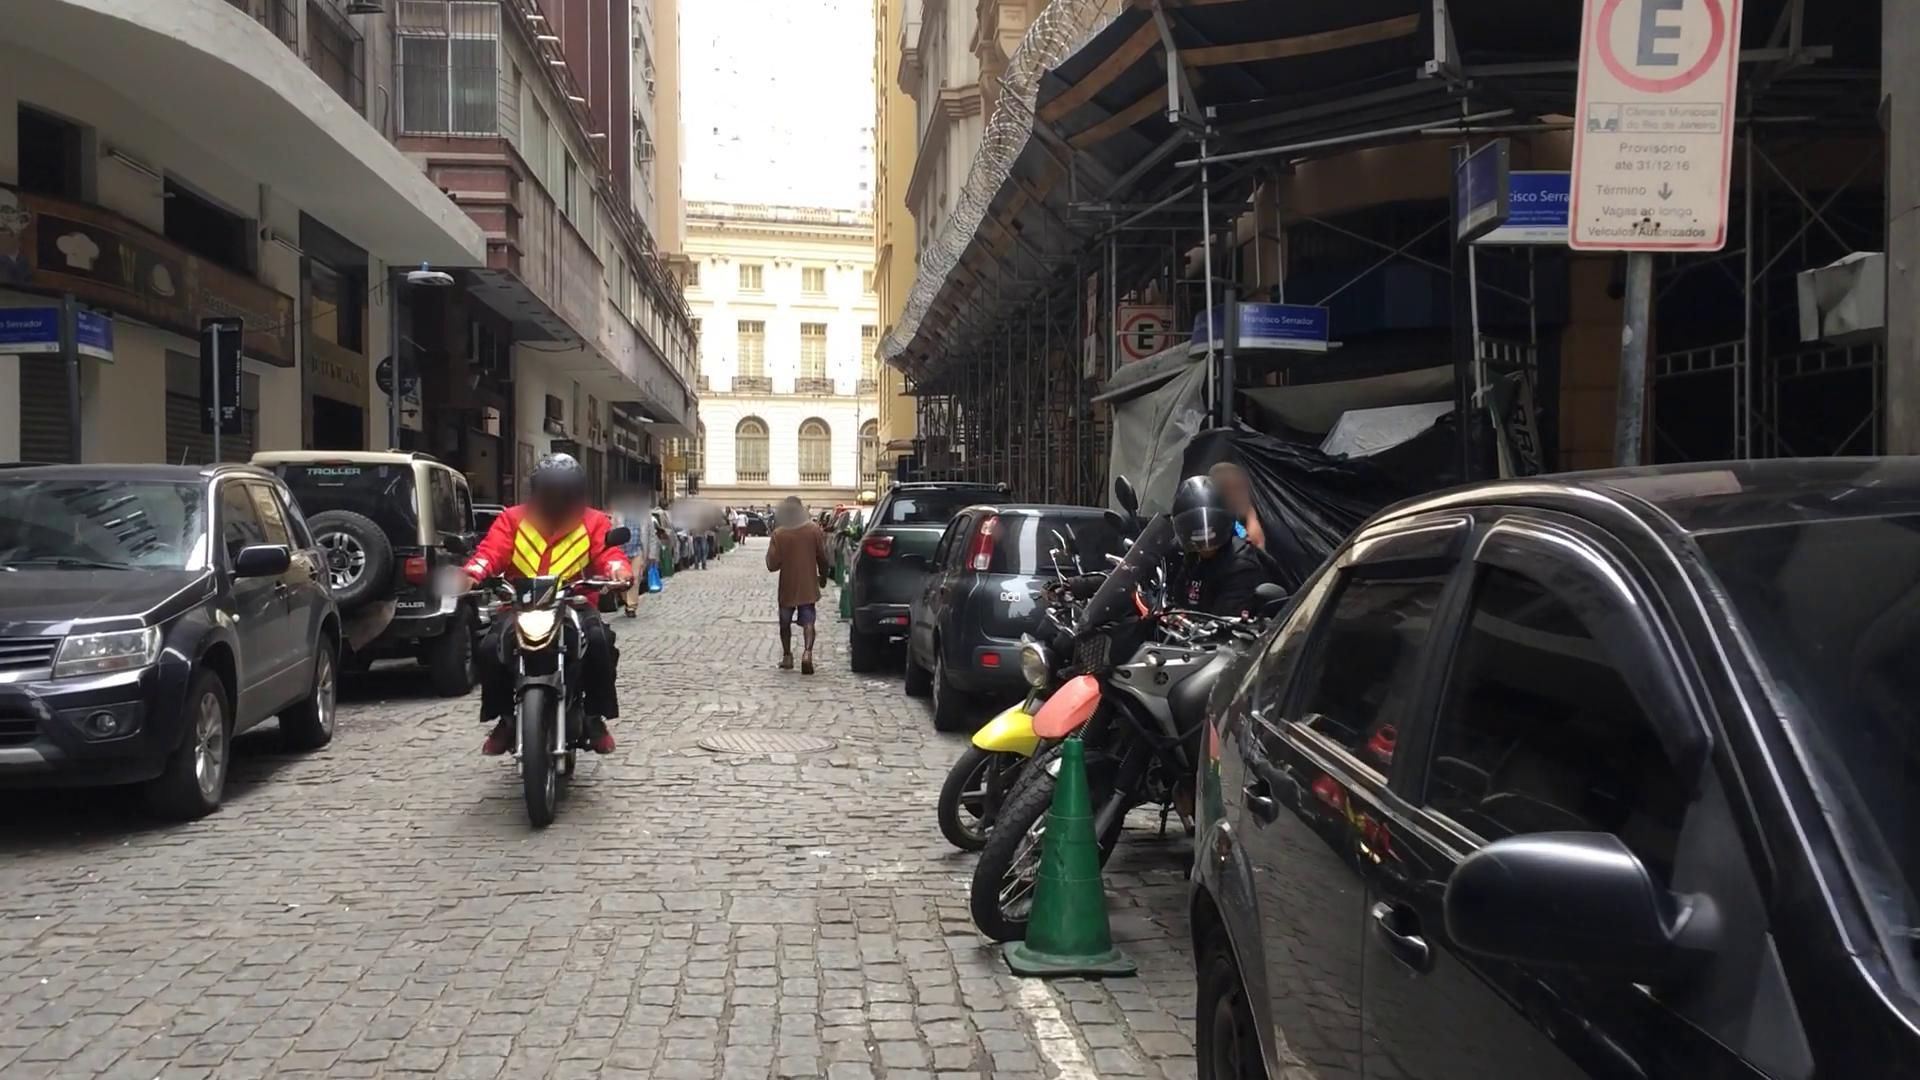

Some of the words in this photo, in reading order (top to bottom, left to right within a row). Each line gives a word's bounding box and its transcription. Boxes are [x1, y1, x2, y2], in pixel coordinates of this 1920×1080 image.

[1636, 0, 1683, 66] E
[1596, 184, 1647, 196] Término
[1602, 206, 1638, 218] Vagas
[1640, 207, 1655, 217] ao
[1658, 206, 1692, 218] longo
[1638, 226, 1706, 238] Autorizados
[6, 319, 43, 330] Serrador
[1281, 316, 1315, 326] Serrador
[1138, 323, 1154, 350] E
[306, 467, 361, 476] TROLLER
